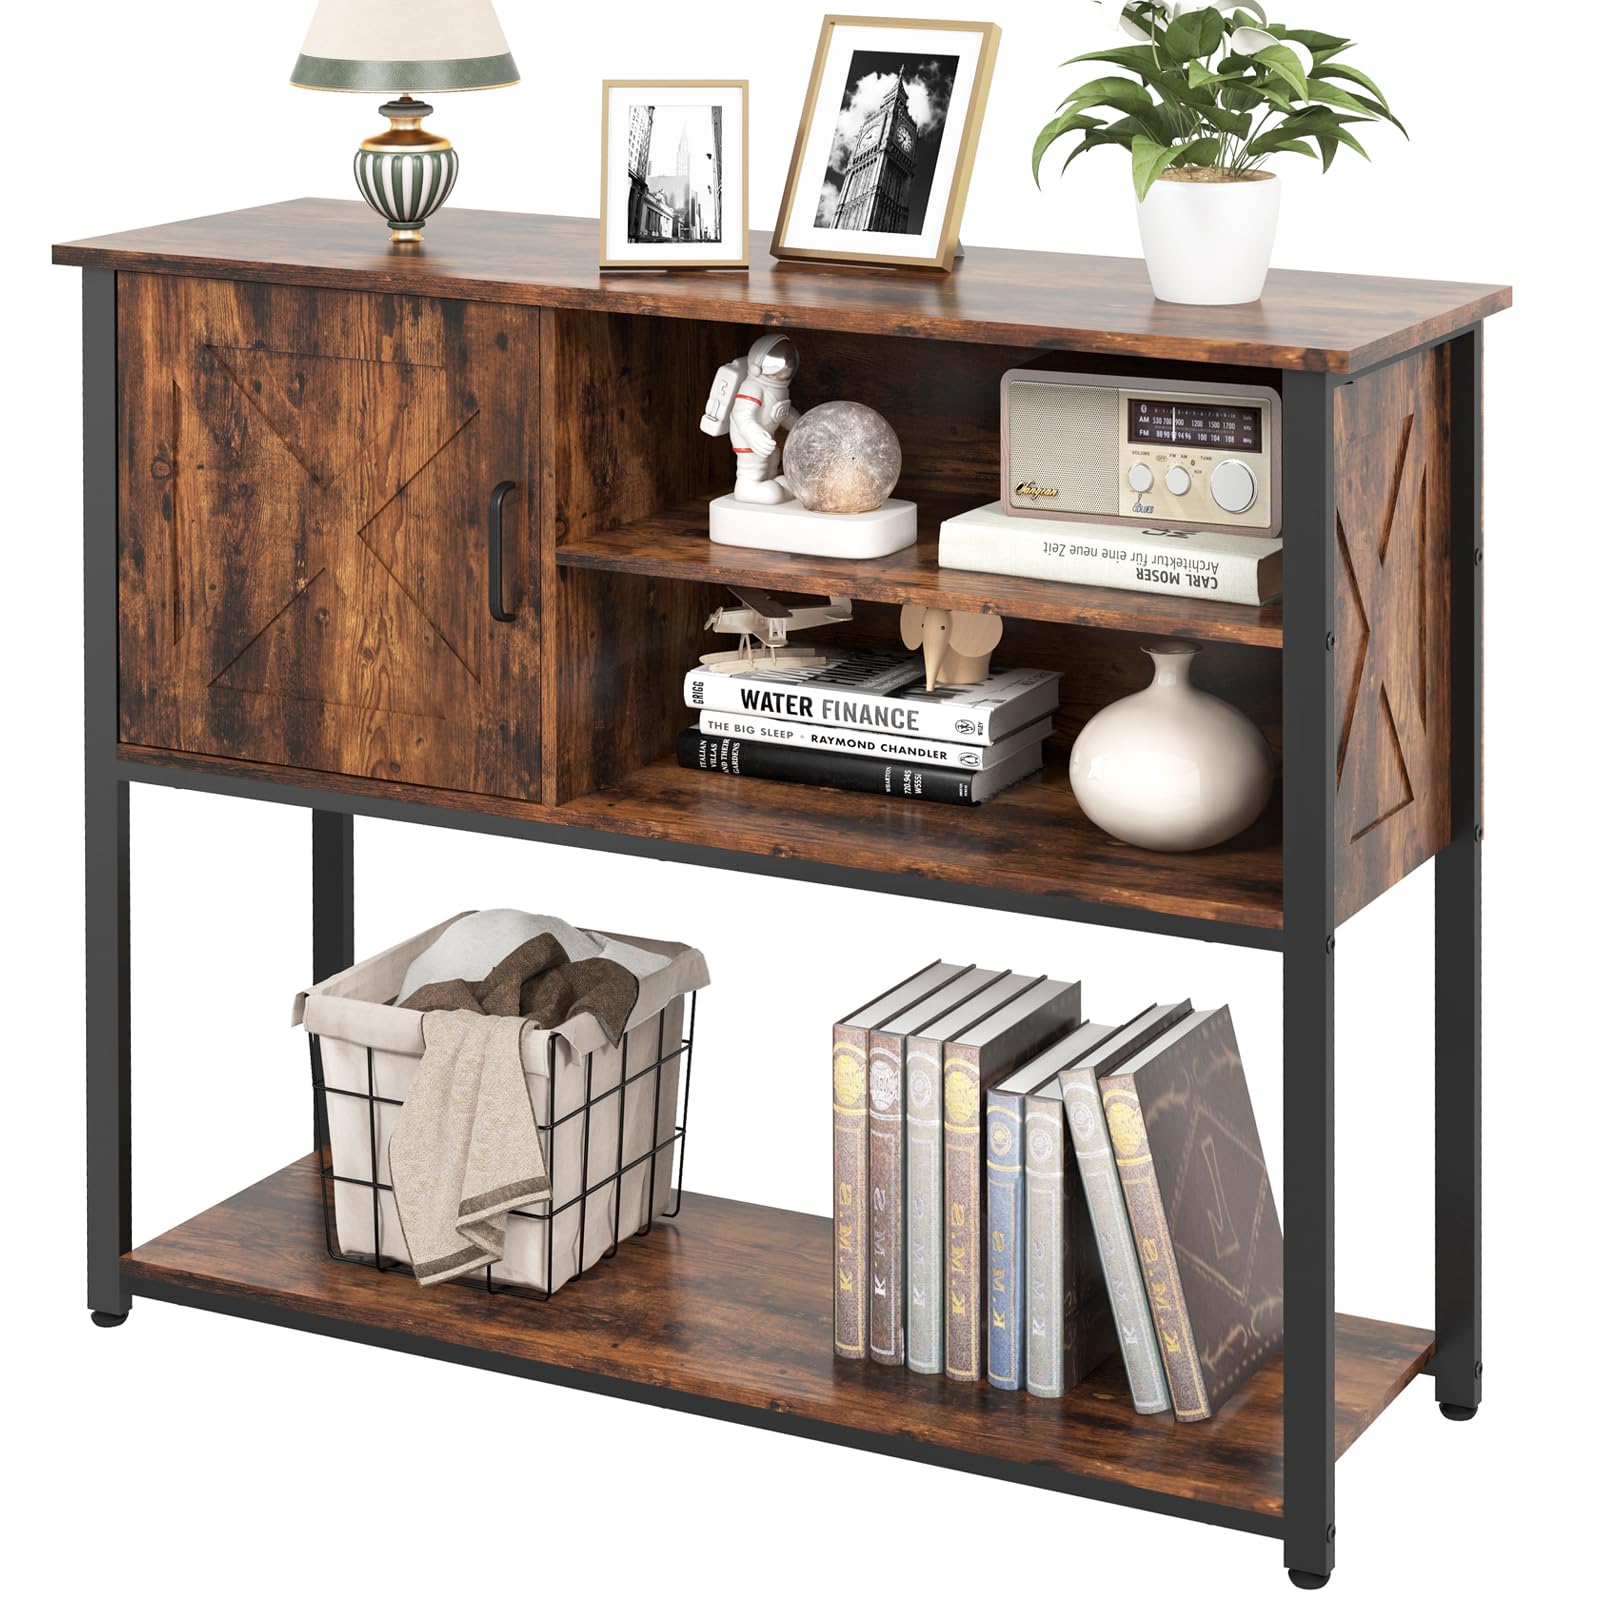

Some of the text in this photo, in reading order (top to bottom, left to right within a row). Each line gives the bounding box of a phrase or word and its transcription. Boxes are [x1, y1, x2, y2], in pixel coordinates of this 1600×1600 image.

[1139, 415, 1150, 423] AM
[1152, 416, 1162, 425] 530
[1191, 419, 1203, 428] 1200
[1208, 420, 1220, 429] 1500
[1222, 421, 1236, 430] 1700
[1139, 429, 1150, 437] FM
[1156, 430, 1163, 439] 88
[1197, 433, 1208, 442] 100
[1210, 434, 1220, 442] 104
[1225, 435, 1235, 444] 108
[1043, 542, 1219, 575] Architektur für eine neue Zeit
[1136, 567, 1218, 590] CARL MOSER
[692, 681, 704, 705] GRIGG
[741, 688, 813, 718] WATER
[822, 699, 920, 731] FINANCE
[707, 720, 948, 760] THE BIG SLEEP RAYMOND CHANDLER
[720, 738, 731, 761] THEIR
[699, 740, 707, 768] ITALIAN
[709, 743, 717, 768] VILLAS
[731, 742, 741, 774] GARDENS
